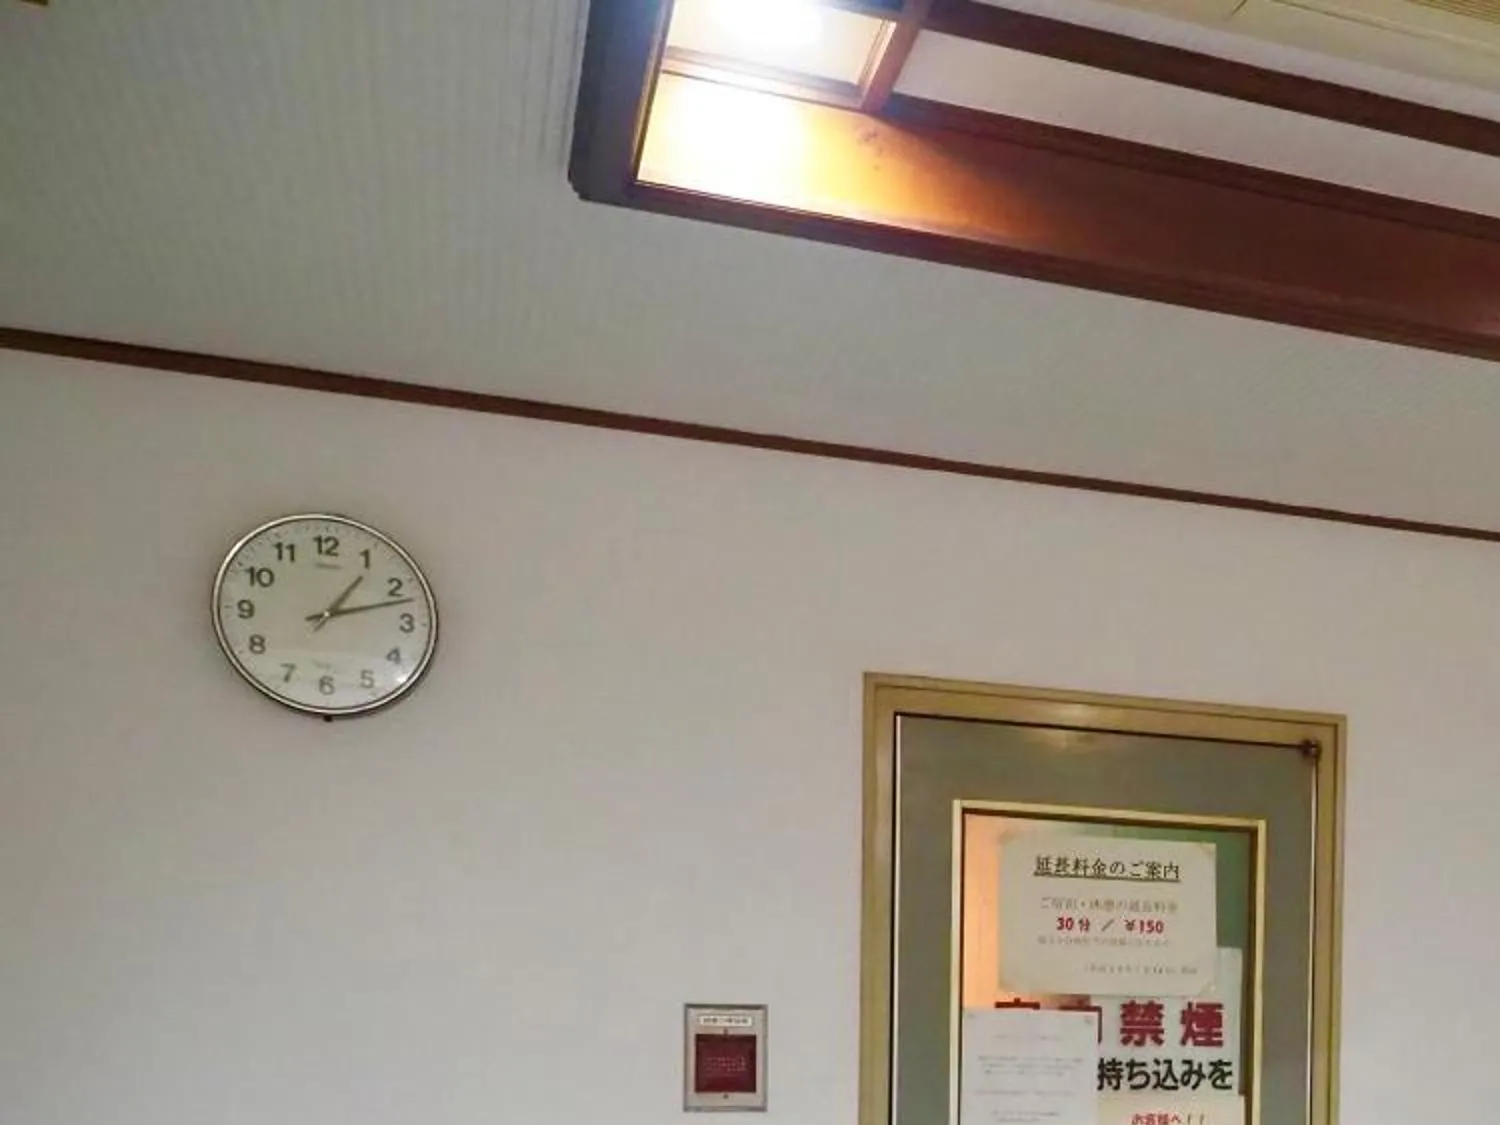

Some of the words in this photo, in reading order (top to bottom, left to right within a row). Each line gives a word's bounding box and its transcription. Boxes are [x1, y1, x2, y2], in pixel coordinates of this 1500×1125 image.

[273, 542, 297, 563] 11
[313, 535, 340, 557] 12
[359, 549, 370, 569] 1
[247, 566, 275, 588] 10
[387, 577, 403, 598] 2
[237, 599, 255, 619] 9
[399, 613, 415, 633] 3
[249, 634, 266, 654] 8
[386, 647, 401, 664] 4
[280, 663, 297, 683] 7
[360, 669, 374, 689] 5
[319, 675, 335, 695] 6
[1034, 856, 1181, 881] 延長料金のご案内
[1097, 1058, 1233, 1092] 持ち込みを
